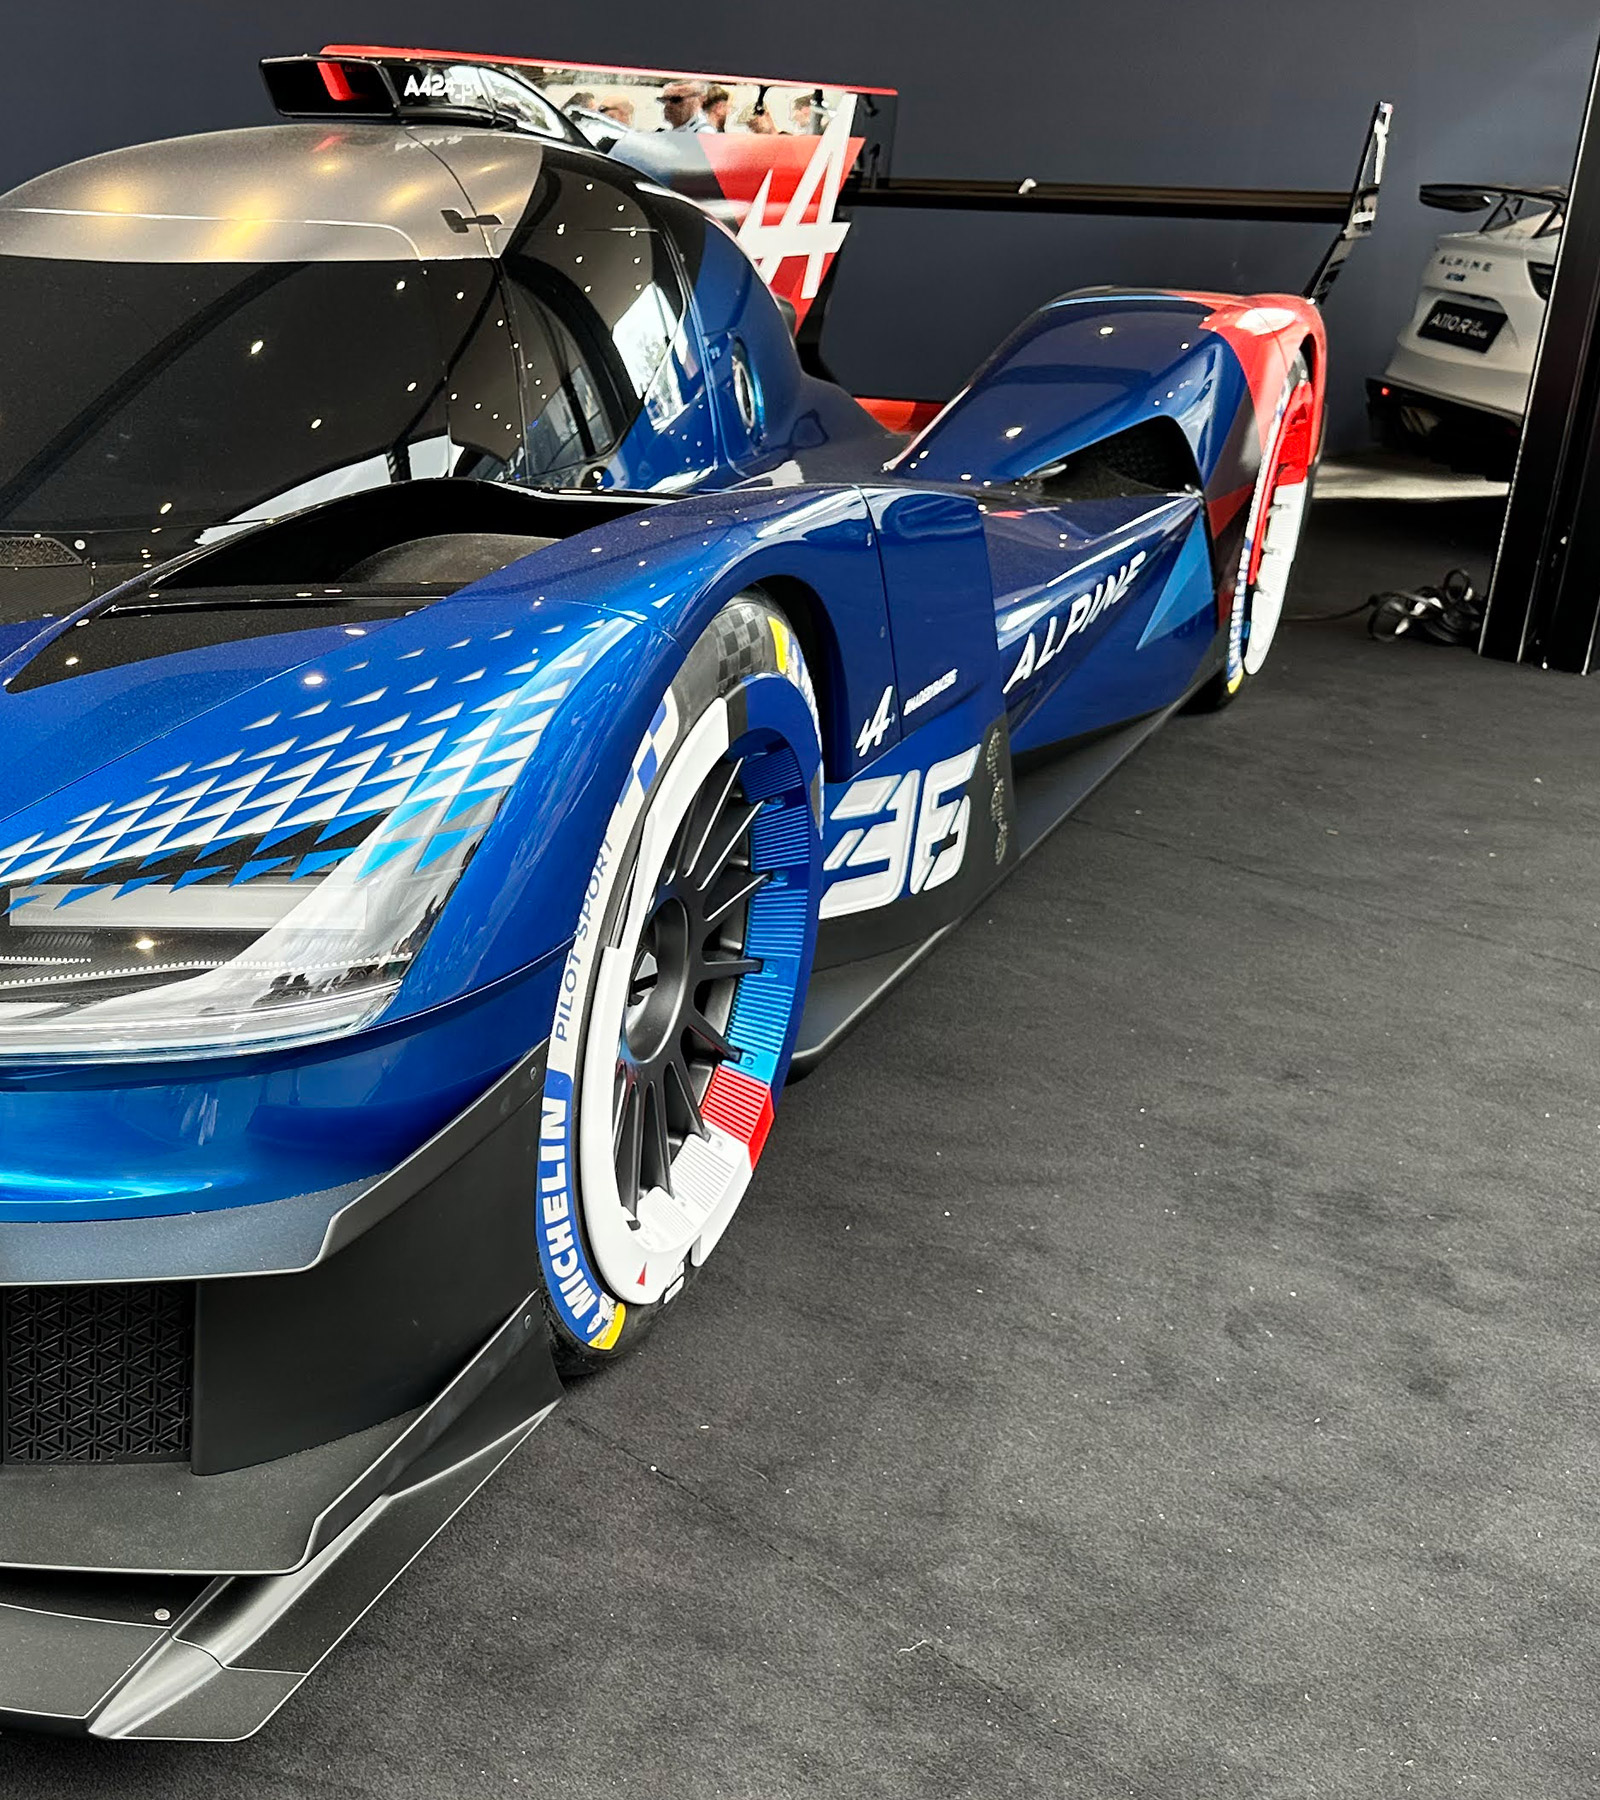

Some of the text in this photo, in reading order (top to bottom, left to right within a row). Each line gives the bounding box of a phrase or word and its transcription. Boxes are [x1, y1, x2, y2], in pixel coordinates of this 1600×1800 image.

[1002, 550, 1147, 694] ALPINE
[818, 743, 981, 920] 36
[555, 949, 583, 1042] PILOT
[540, 1096, 597, 1320] MICHELIN
